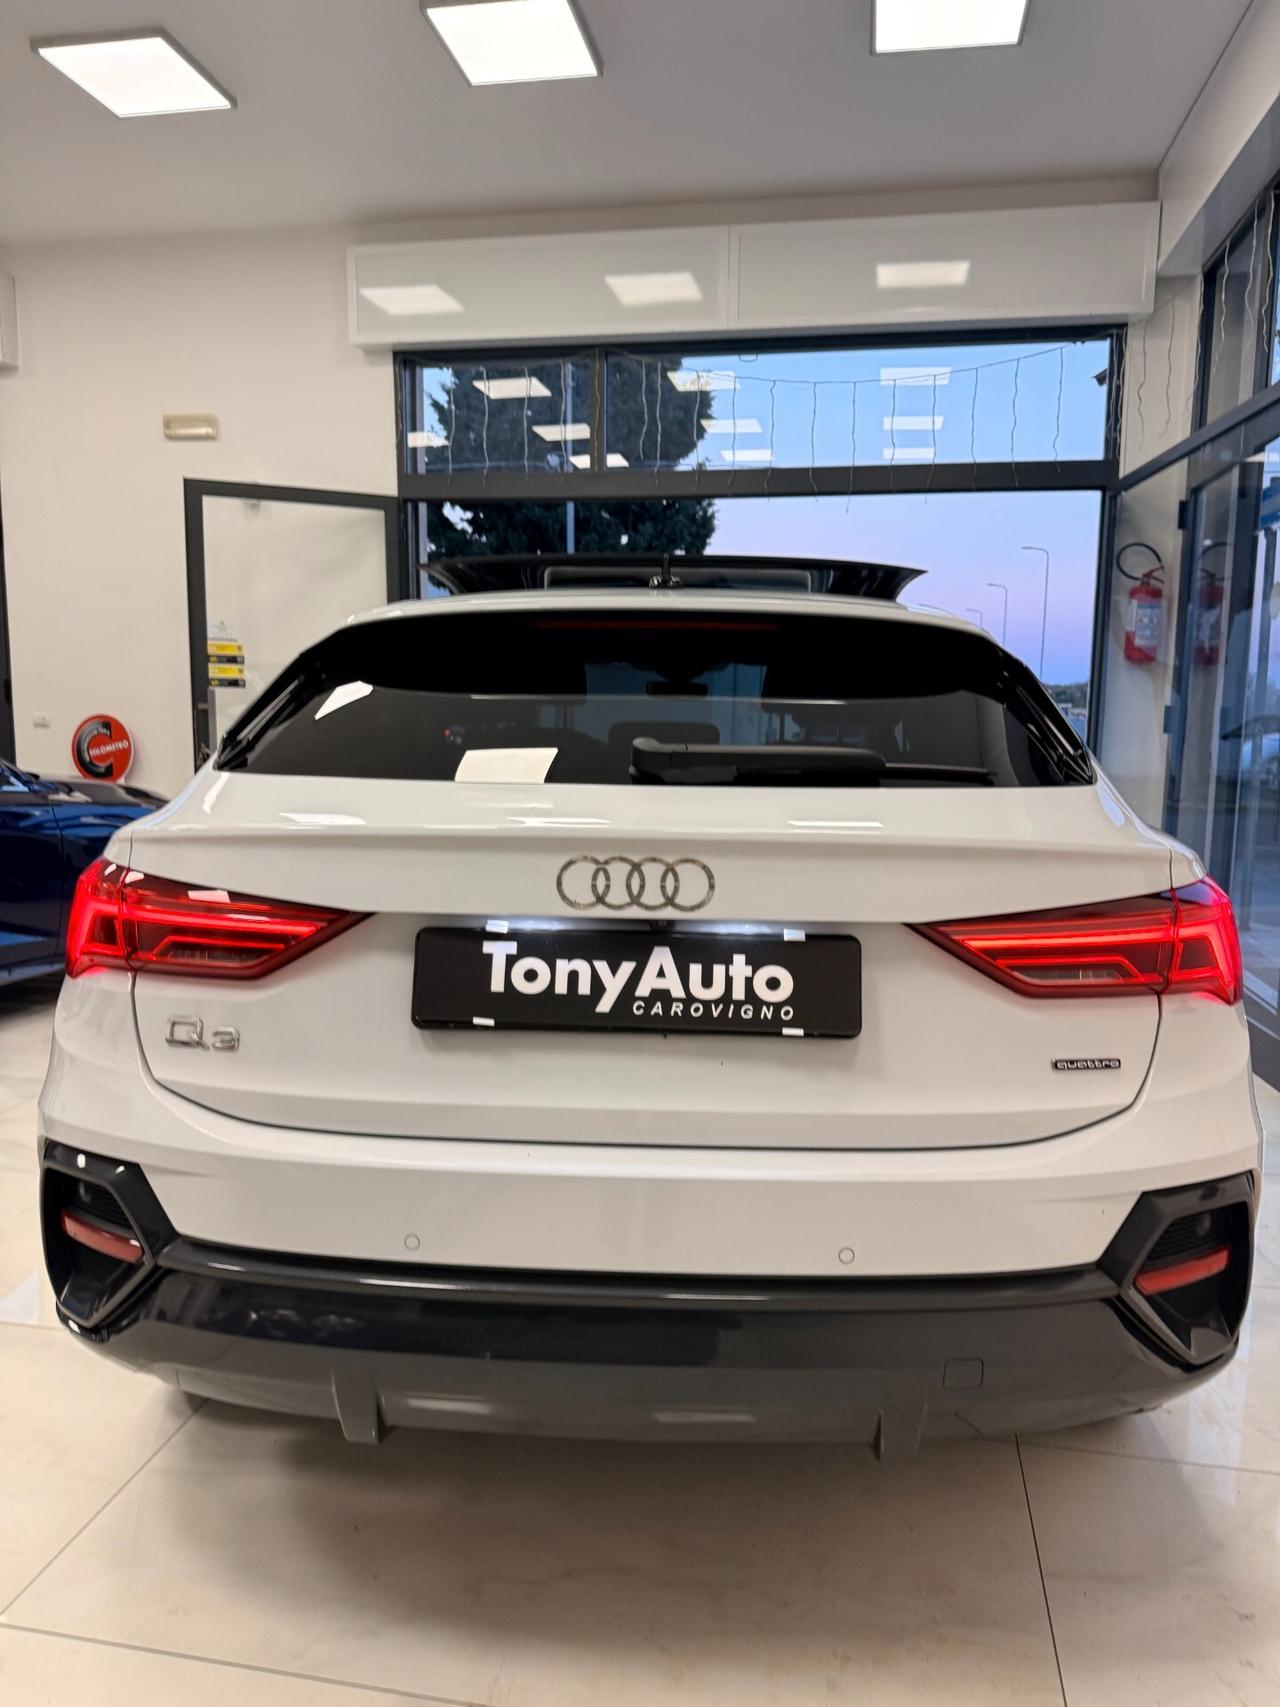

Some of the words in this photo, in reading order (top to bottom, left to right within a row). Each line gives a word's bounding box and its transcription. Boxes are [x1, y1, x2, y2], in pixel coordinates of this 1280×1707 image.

[482, 941, 795, 1013] TonyAuto
[632, 1000, 795, 1021] CAROVIGNO
[165, 1017, 240, 1051] Q3
[1056, 1059, 1120, 1070] quattro
